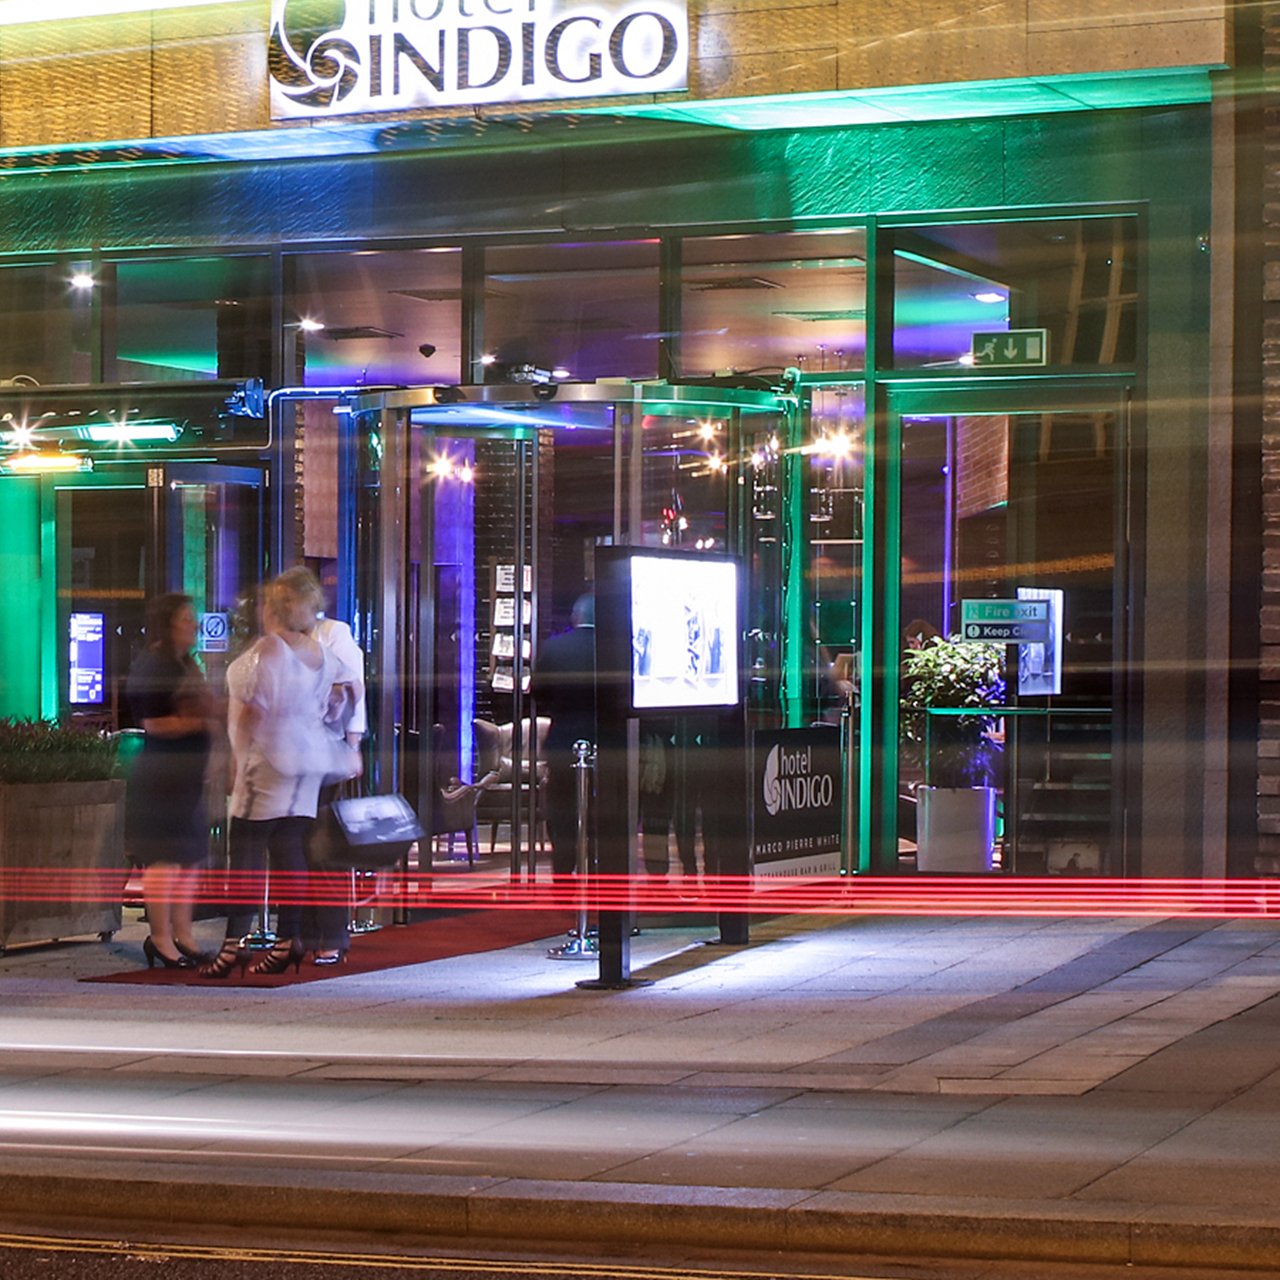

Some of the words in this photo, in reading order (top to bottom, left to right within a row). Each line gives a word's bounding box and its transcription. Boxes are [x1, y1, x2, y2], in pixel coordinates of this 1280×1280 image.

[369, 11, 679, 97] INDIGO
[984, 606, 1010, 617] Fire
[983, 627, 1010, 637] Keep
[781, 745, 811, 776] hotel
[781, 774, 833, 811] INDIGO
[756, 841, 783, 855] MARCO
[786, 837, 813, 851] PIERRE
